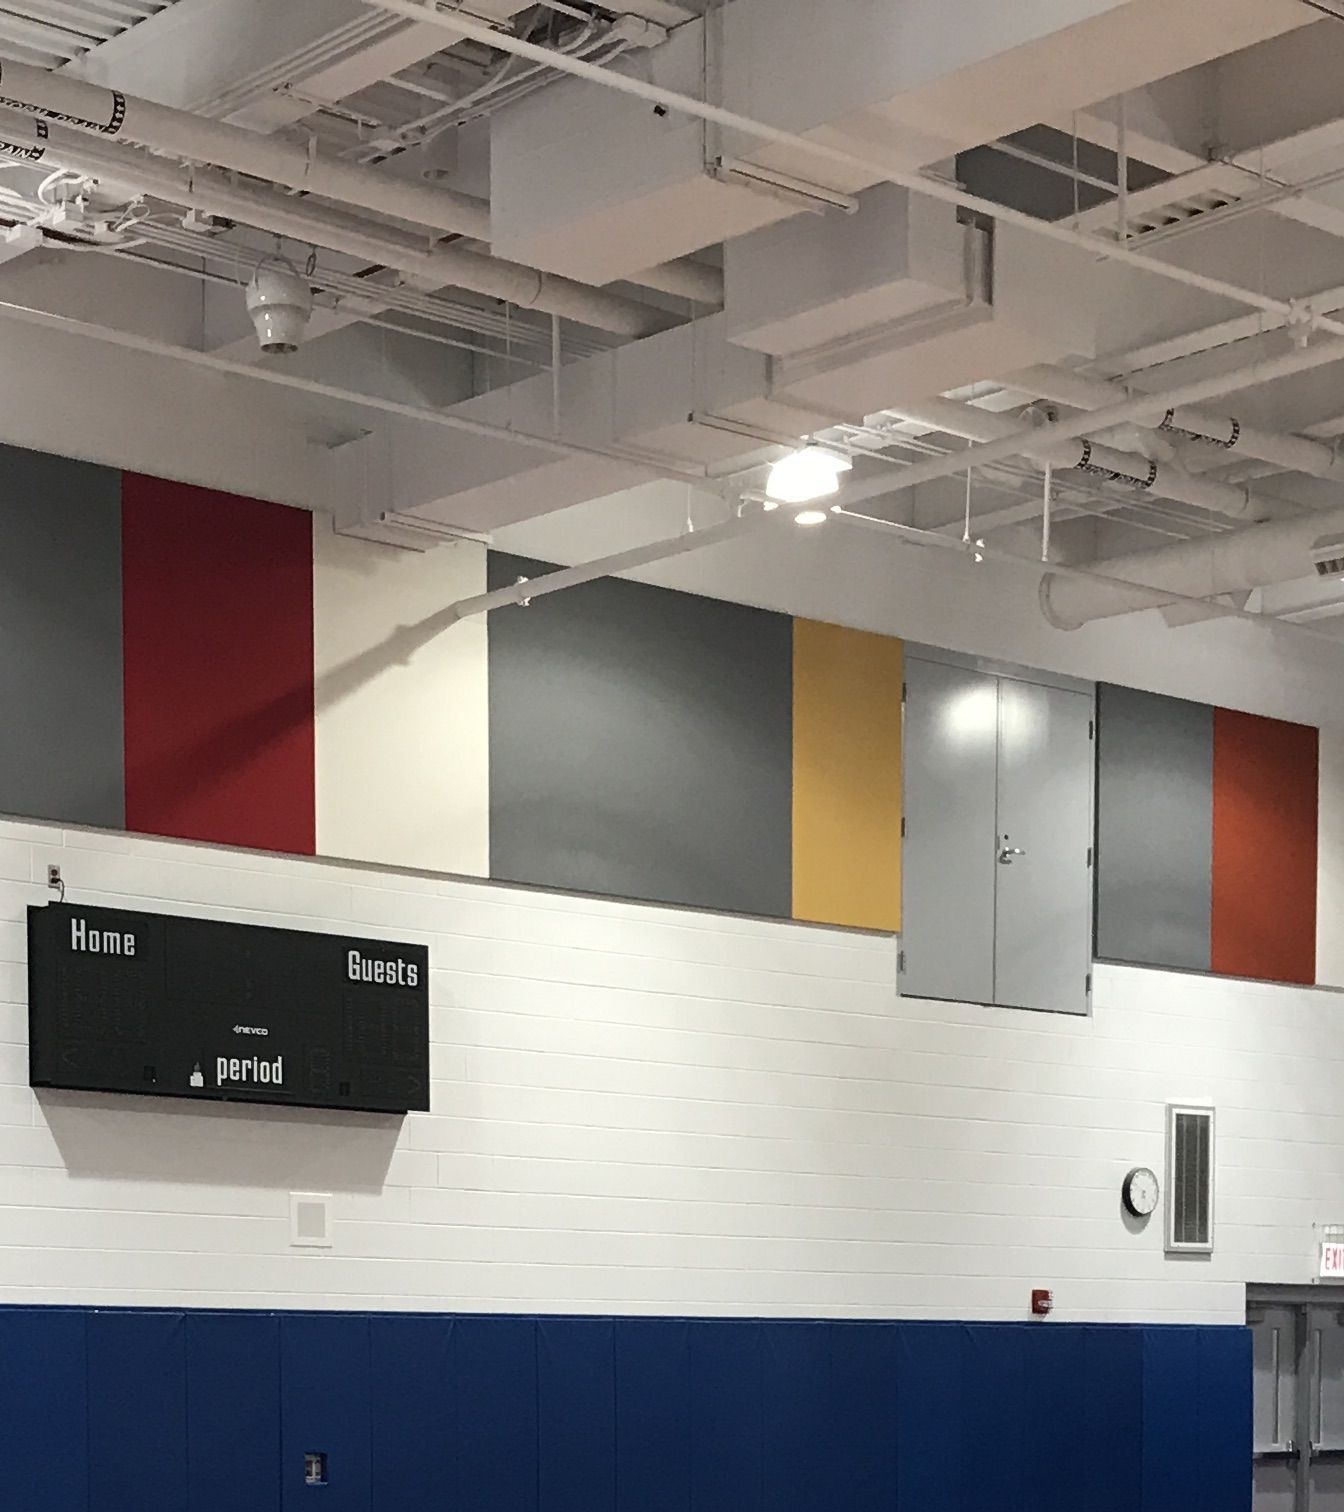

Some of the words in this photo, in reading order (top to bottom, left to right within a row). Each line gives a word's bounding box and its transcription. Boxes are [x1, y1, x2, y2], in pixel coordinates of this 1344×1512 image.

[72, 919, 134, 955] Home
[349, 951, 417, 986] Guests
[217, 1056, 282, 1085] period
